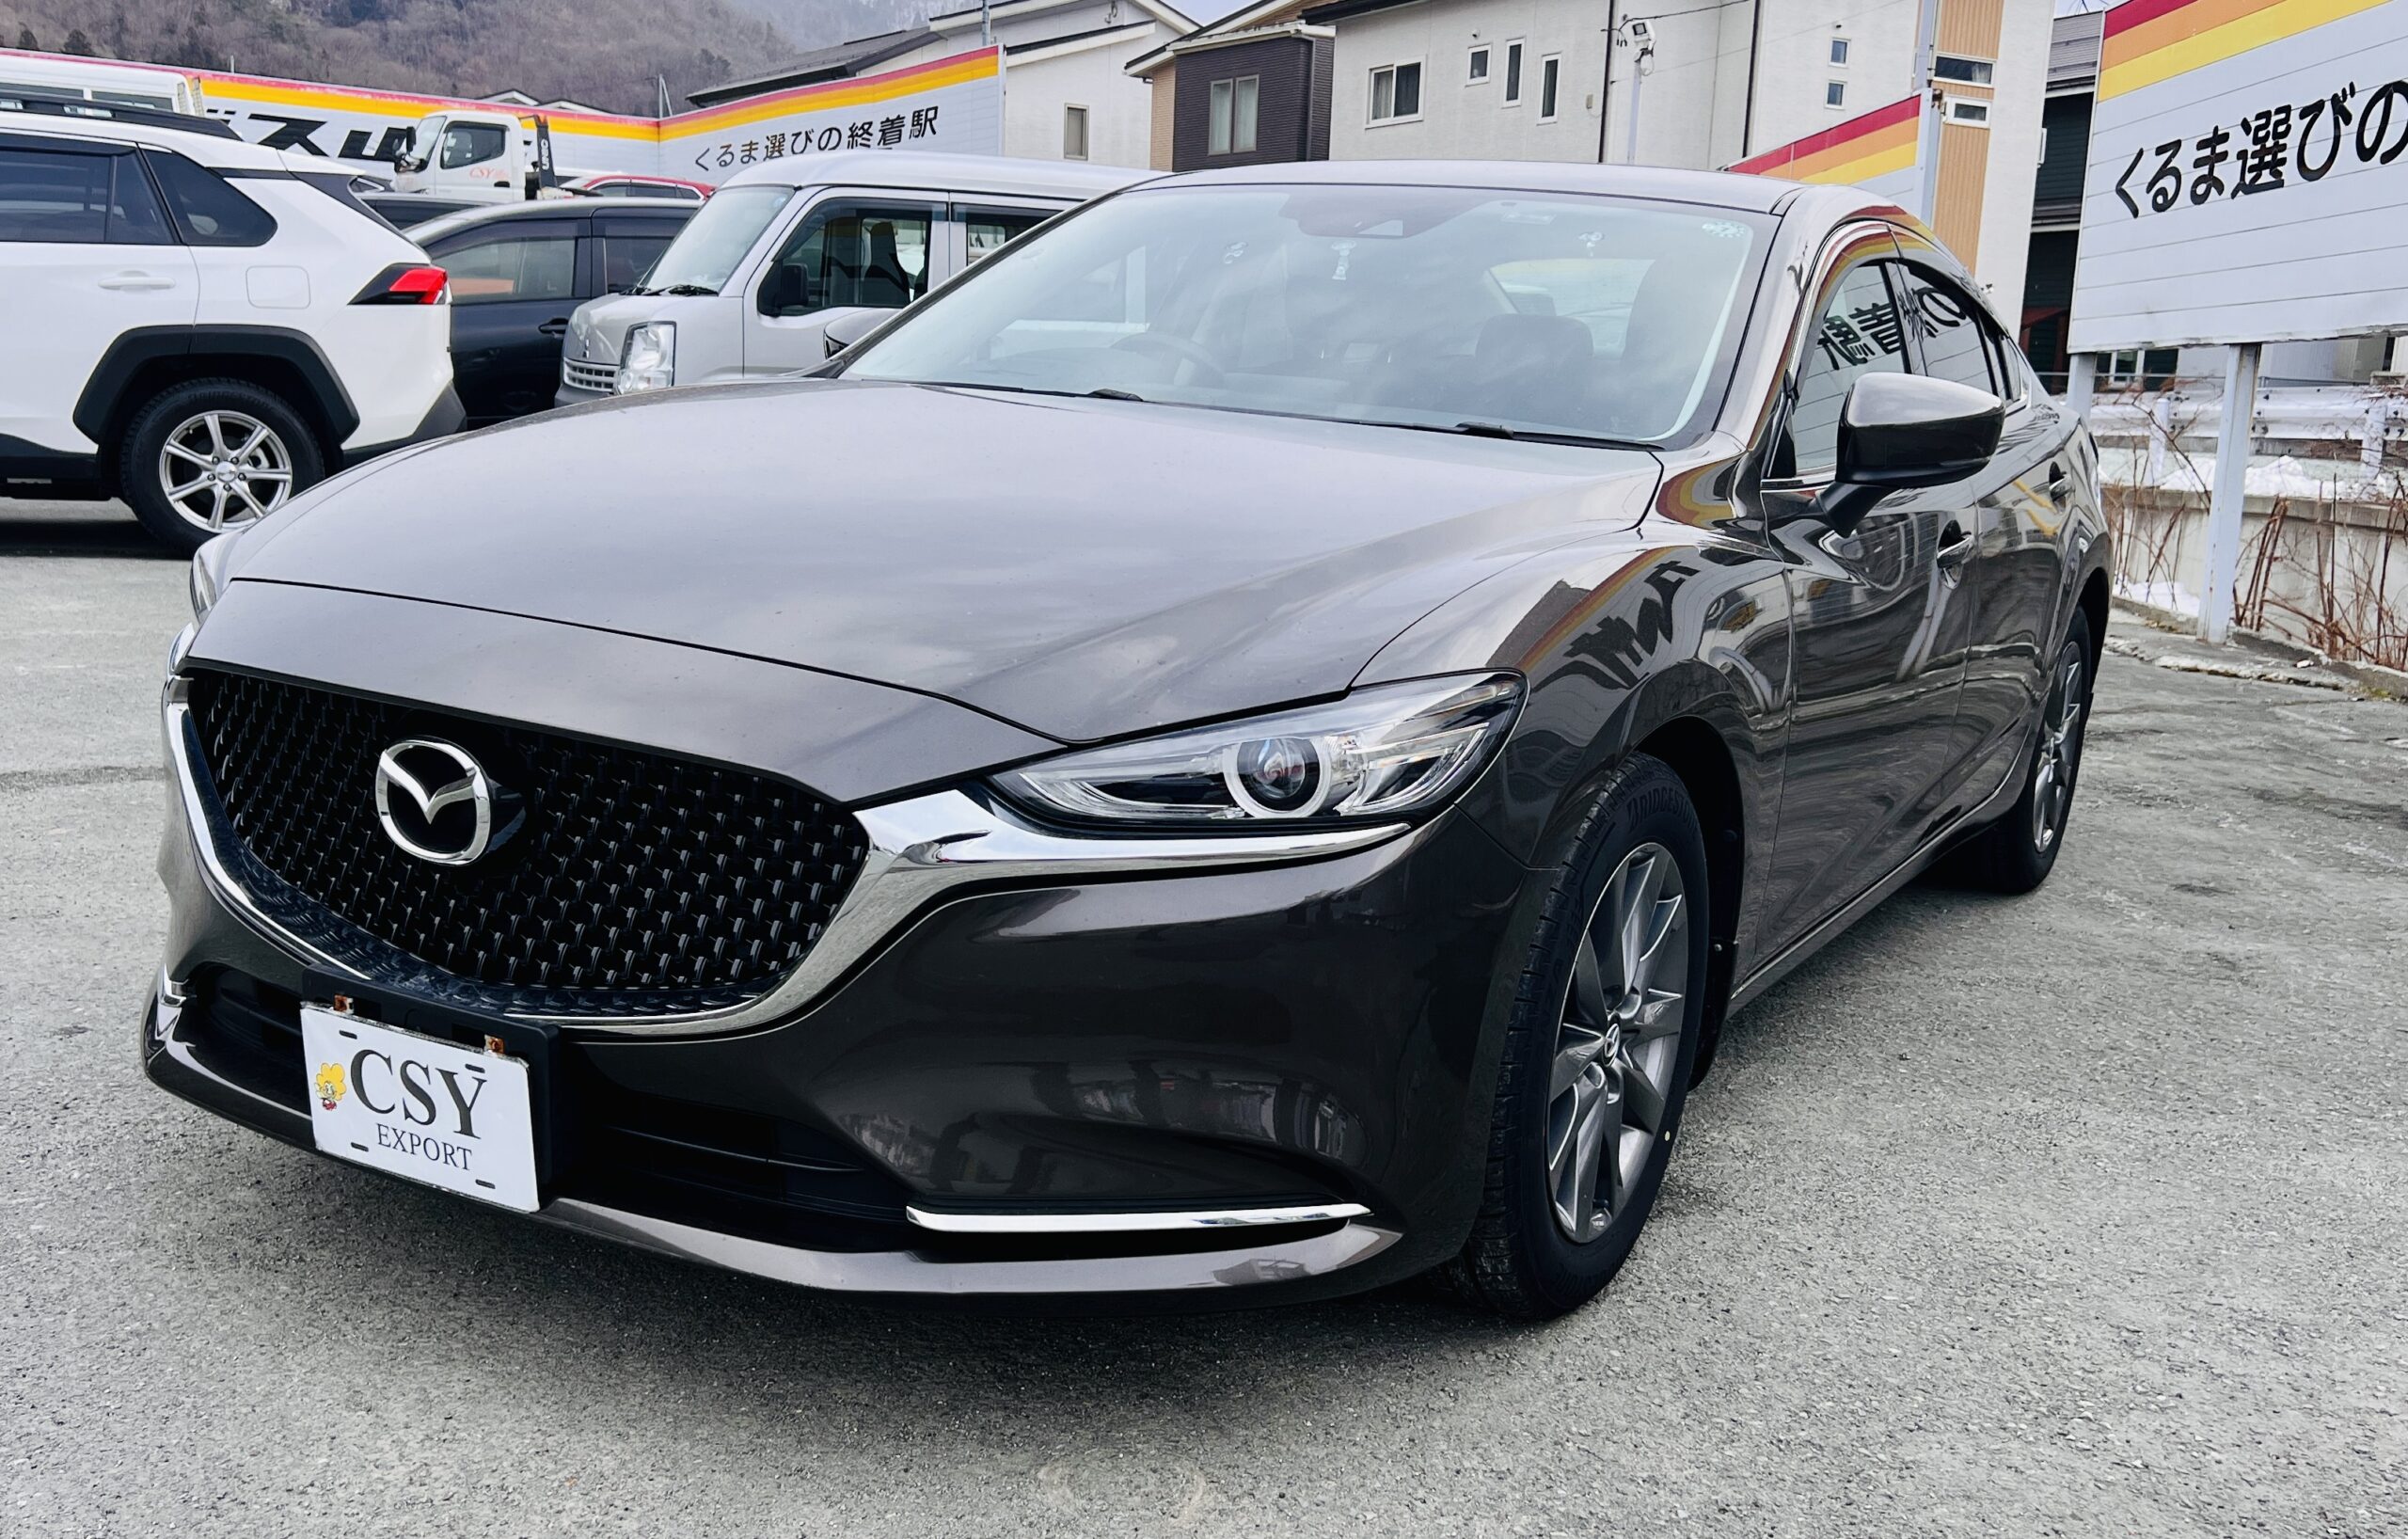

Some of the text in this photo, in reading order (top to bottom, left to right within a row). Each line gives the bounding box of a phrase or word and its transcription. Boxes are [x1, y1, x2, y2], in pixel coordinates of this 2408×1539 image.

[694, 105, 939, 171] くるま選びの終着駅
[2115, 80, 2408, 219] くるま選びの
[350, 1049, 488, 1140] CSY
[376, 1122, 472, 1171] EXPORT
